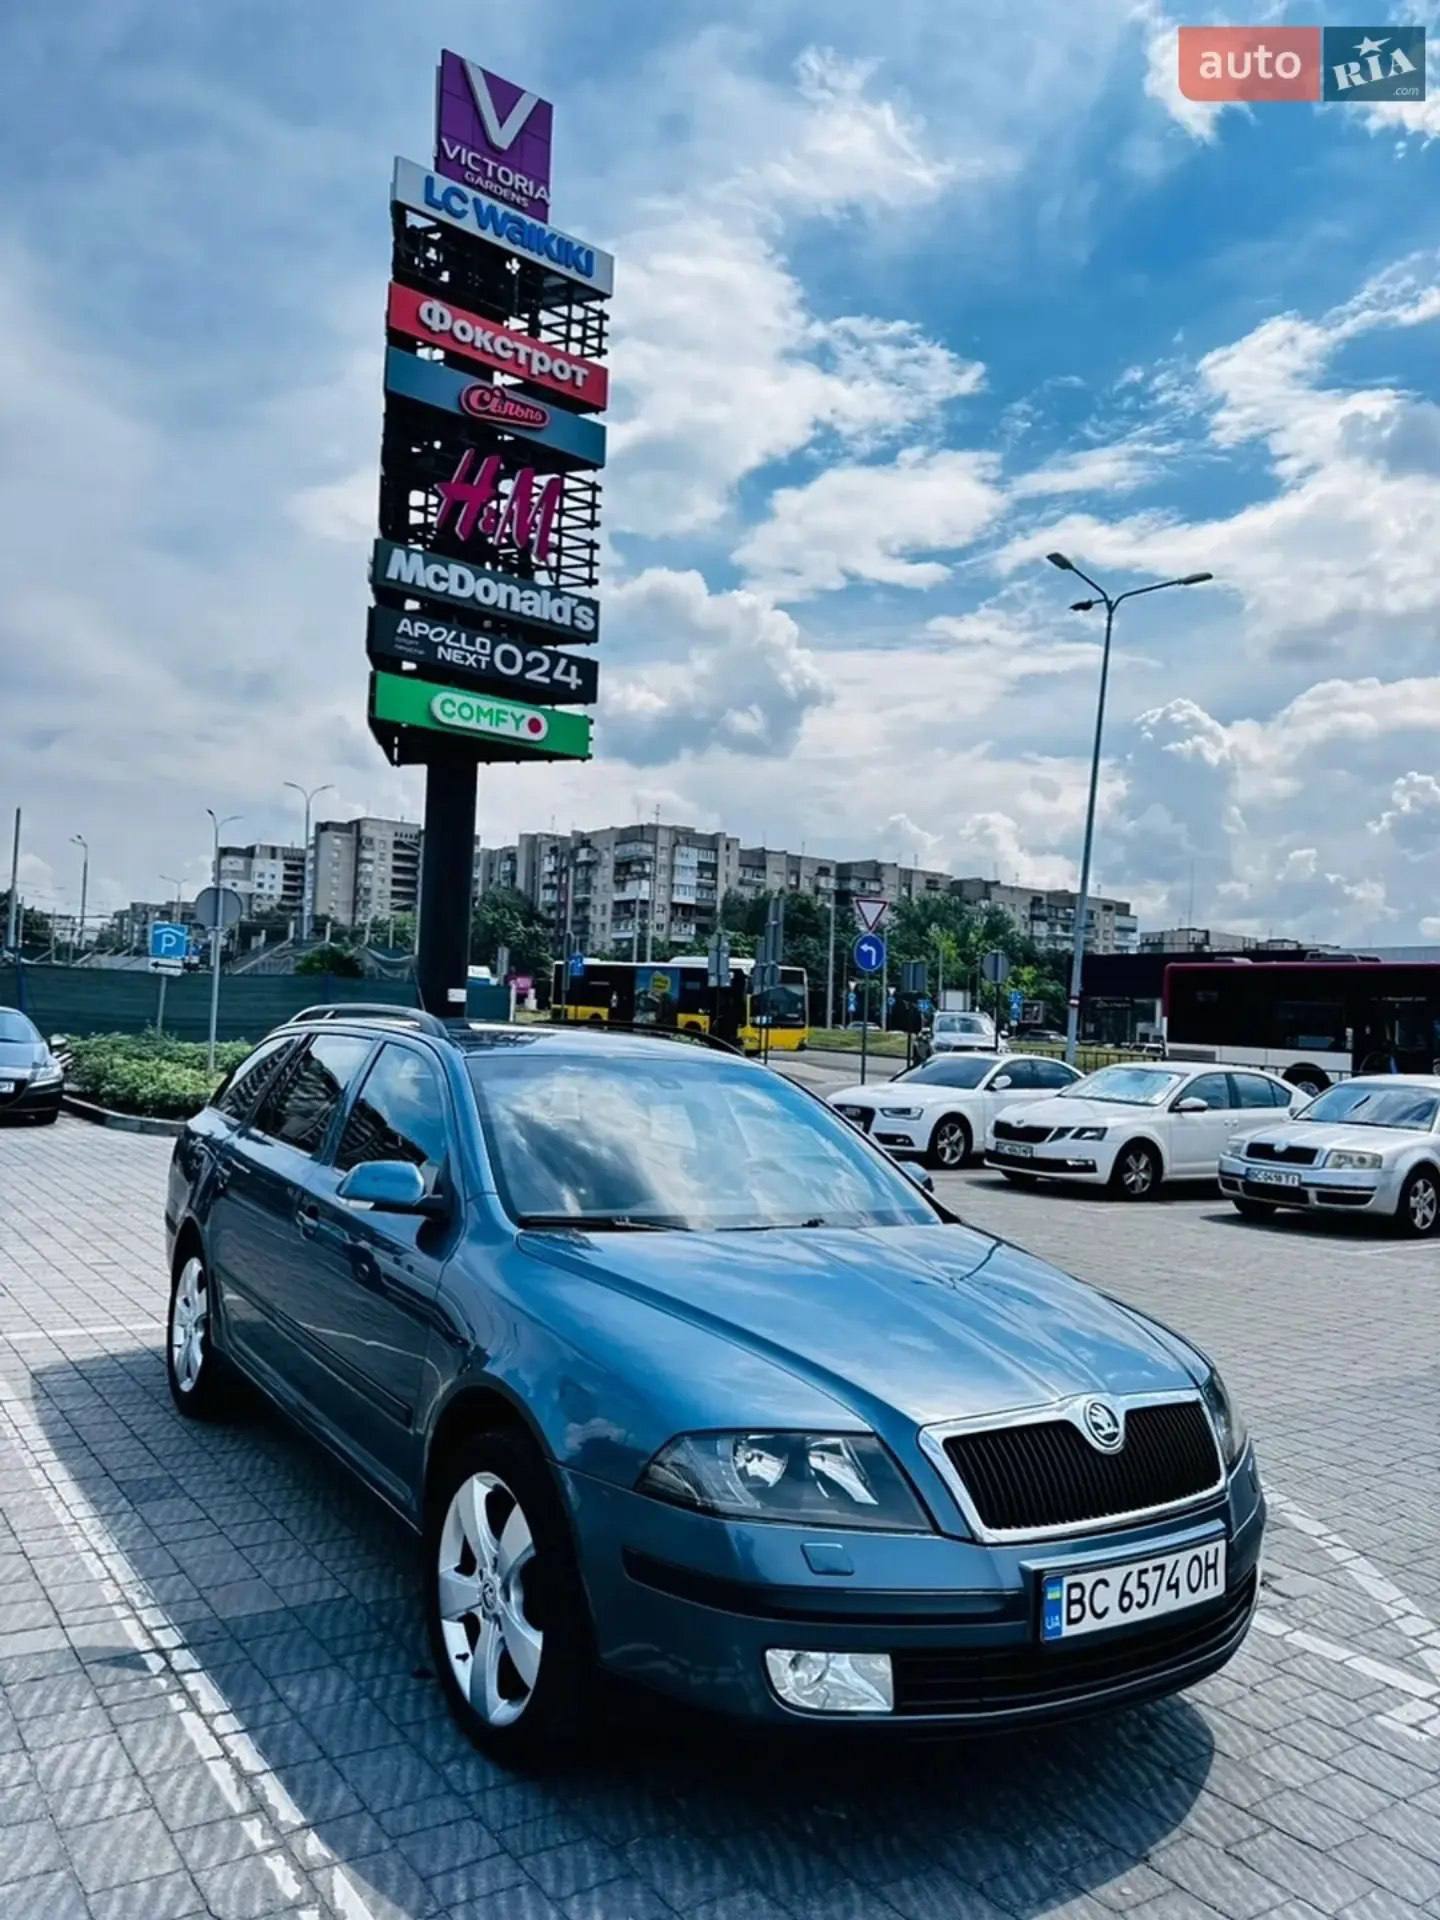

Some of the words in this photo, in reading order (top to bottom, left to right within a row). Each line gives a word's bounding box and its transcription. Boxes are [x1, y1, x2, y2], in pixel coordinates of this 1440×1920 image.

[441, 137, 550, 200] VICTORIA
[424, 175, 468, 219] LC
[464, 171, 529, 208] GARDENS
[419, 300, 588, 388] Фокстрот
[469, 389, 542, 421] Сільпо
[434, 448, 564, 563] H&M
[385, 548, 595, 632] McDonald's
[397, 618, 491, 655] APOLLO
[437, 646, 490, 670] NEXT
[439, 698, 525, 732] COMFY
[160, 933, 177, 954] P
[1066, 1578, 1110, 1627] BC
[1118, 1559, 1180, 1614] 6574
[1187, 1547, 1219, 1595] OH
[1045, 1615, 1062, 1630] UA
